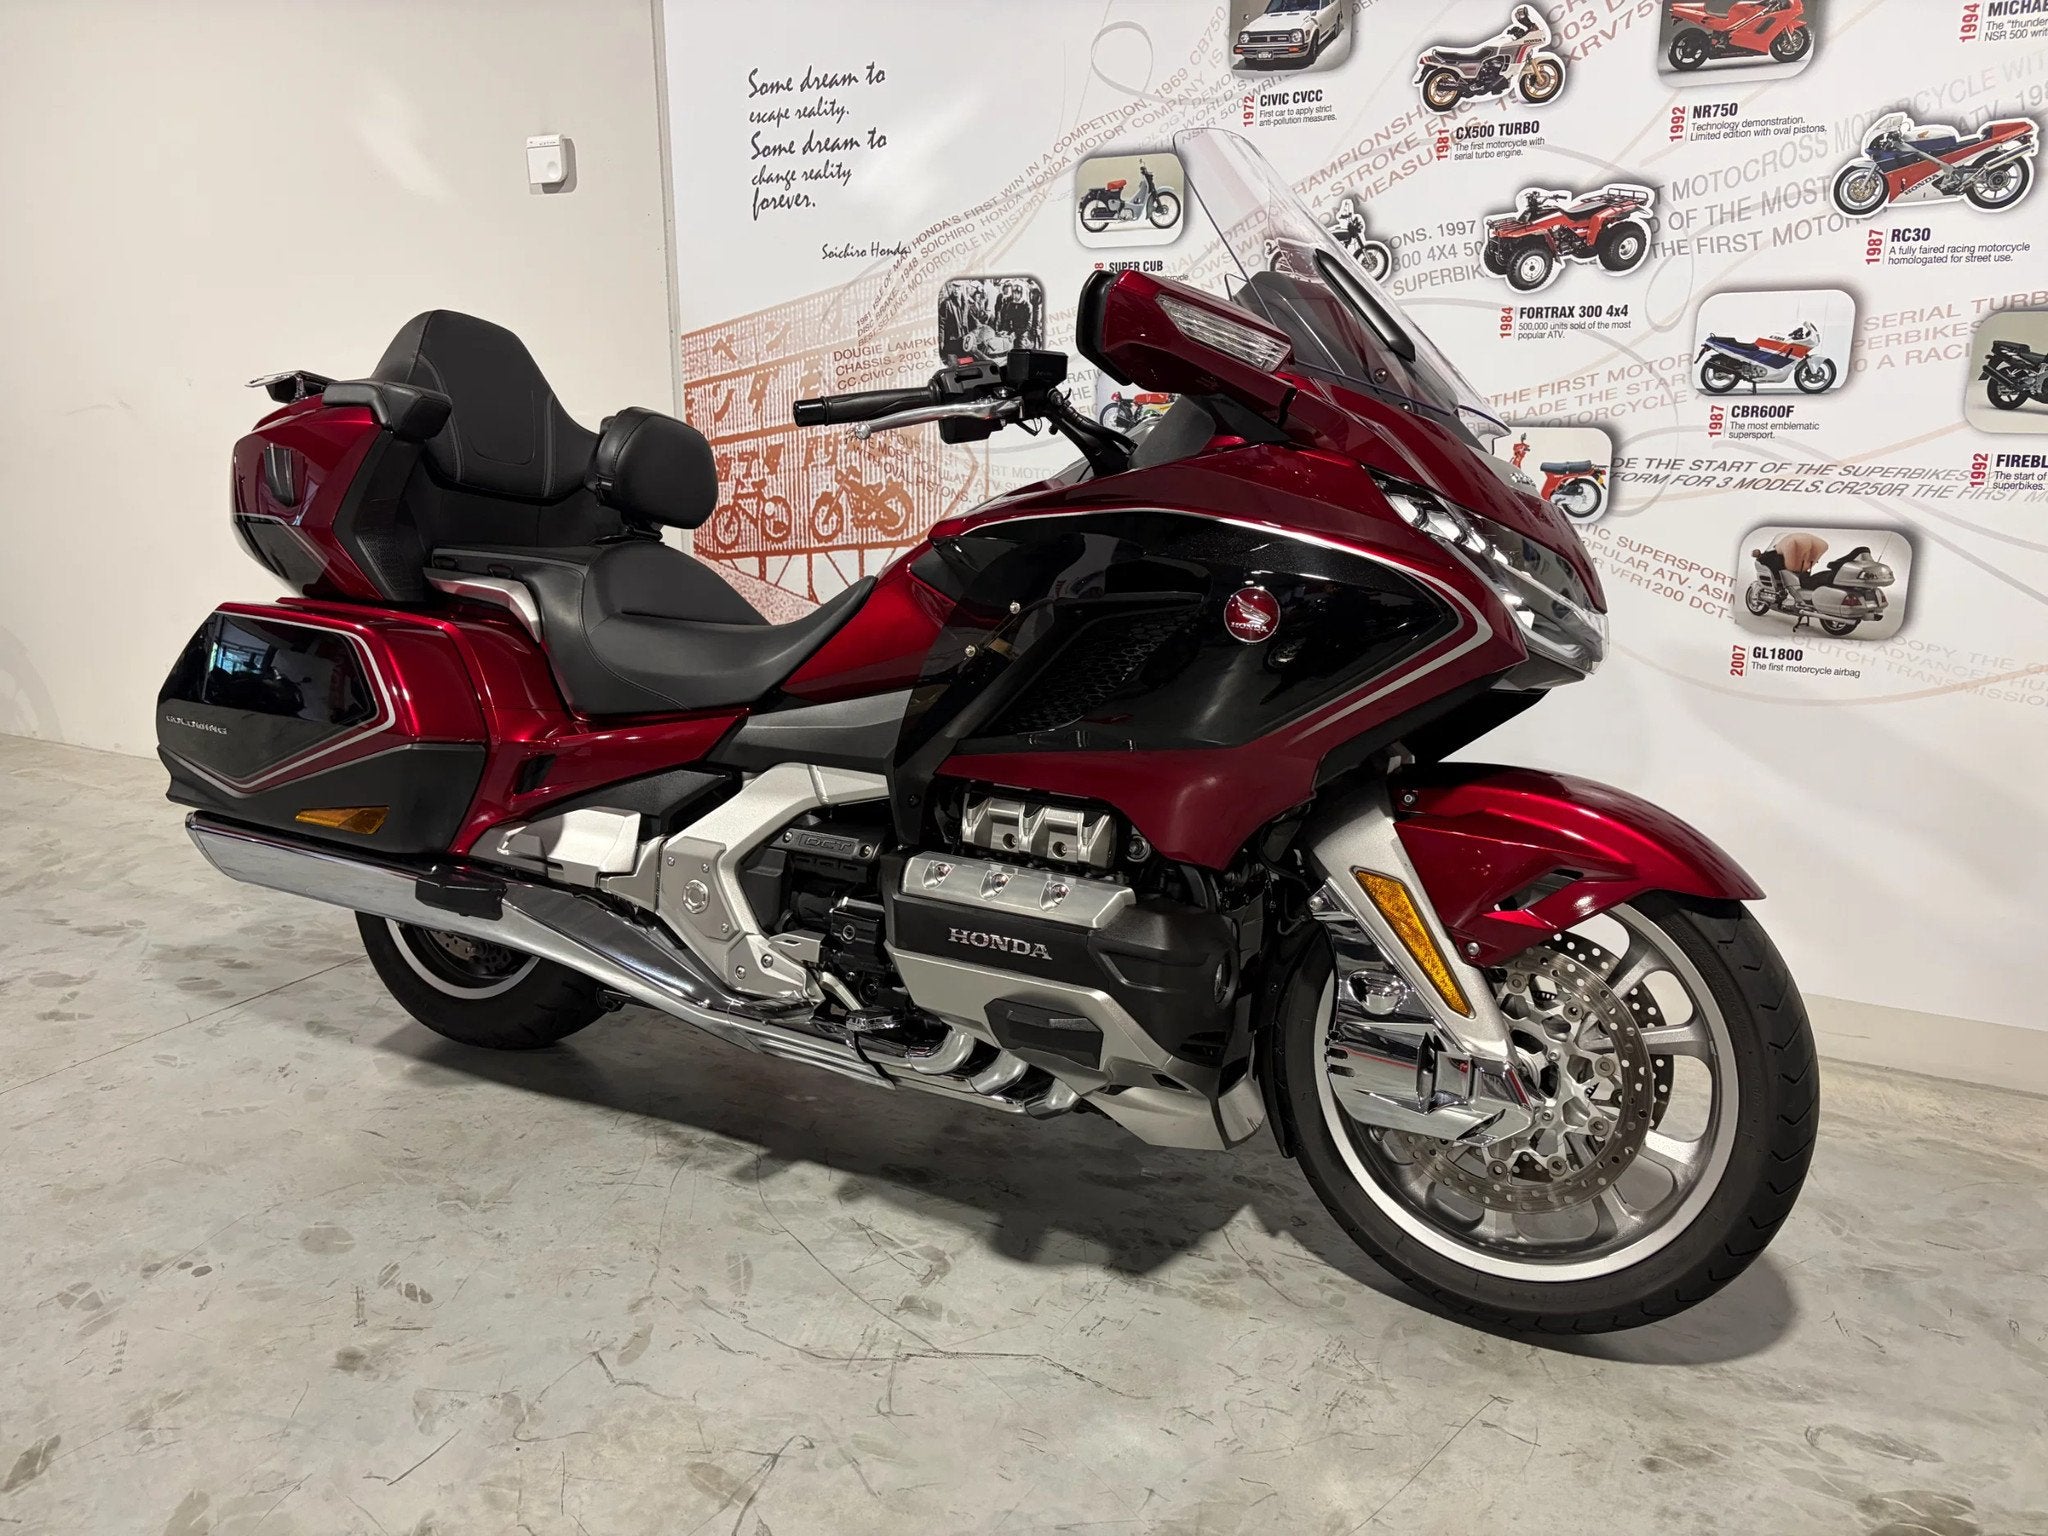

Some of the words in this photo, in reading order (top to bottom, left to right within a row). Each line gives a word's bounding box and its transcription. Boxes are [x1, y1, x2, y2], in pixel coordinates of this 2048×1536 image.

[1960, 3, 1980, 42] 1994
[1986, 21, 2004, 31] The
[1984, 31, 2007, 42] NSR
[2009, 29, 2028, 40] 500
[748, 67, 794, 99] Some
[800, 65, 860, 93] dream
[865, 61, 886, 85] to
[1260, 91, 1290, 107] CIVIC
[1292, 89, 1324, 104] CVCC
[749, 107, 791, 128] escape
[794, 96, 850, 125] reality.
[1243, 95, 1255, 127] 1972
[1259, 108, 1274, 119] First
[1274, 109, 1286, 117] car
[1287, 108, 1295, 116] to
[1295, 106, 1315, 117] apply
[1315, 104, 1332, 114] strict
[1259, 116, 1302, 127] anti-pollution
[1302, 114, 1338, 123] measures.
[1692, 102, 1739, 119] NR750
[911, 215, 962, 249] HONDA'S
[963, 196, 1001, 221] FIRST
[1000, 175, 1025, 199] WIN
[1025, 161, 1041, 179] IN
[1041, 151, 1054, 166] A
[1053, 97, 1153, 155] COMPETITION.
[1154, 67, 1190, 100] 1969
[1189, 5, 1228, 67] CB750
[1455, 124, 1495, 141] CX500
[1498, 120, 1541, 137] TURBO
[1669, 106, 1686, 142] 1992
[1690, 128, 1722, 142] Limited
[1722, 127, 1752, 140] edition
[1753, 127, 1772, 138] with
[1773, 125, 1790, 136] oval
[1791, 123, 1828, 137] pistons.
[1691, 118, 1741, 132] Technology
[1741, 115, 1806, 129] demonstration.
[750, 130, 796, 160] Some
[802, 129, 861, 155] dream
[866, 127, 888, 150] to
[919, 222, 976, 259] SOICHIRO
[980, 194, 1025, 228] HONDA
[1027, 155, 1073, 195] HONDA
[1072, 124, 1128, 159] MOTOR
[1131, 72, 1207, 129] COMPANY
[1208, 47, 1226, 70] IS
[1436, 128, 1450, 162] 1981
[1455, 142, 1469, 152] The
[1470, 141, 1485, 152] first
[1486, 138, 1528, 151] motorcycle
[1529, 136, 1546, 147] with
[1454, 151, 1474, 161] serial
[1475, 149, 1495, 160] turbo
[1496, 149, 1524, 159] engine.
[751, 164, 797, 192] change
[800, 159, 853, 187] reality
[1311, 132, 1422, 210] 4-STROKE
[1671, 133, 1829, 202] MOTOCROSS
[751, 187, 817, 222] forever.
[1668, 208, 1698, 231] OF
[1704, 195, 1752, 227] THE
[1761, 174, 1831, 217] MOST
[1436, 220, 1477, 238] 1997
[1891, 227, 1932, 244] RC30
[822, 243, 868, 261] Soichiro
[870, 241, 910, 259] Honda
[1427, 245, 1459, 262] 4X4
[1696, 230, 1764, 256] FIRST
[1865, 228, 1884, 266] 1987
[1888, 246, 1898, 256] A
[1898, 244, 1918, 258] fully
[1918, 243, 1946, 256] faired
[1946, 243, 1977, 257] racing
[1977, 241, 2031, 255] motorcycle
[907, 238, 982, 299] MOTORCYCLE
[1108, 261, 1140, 273] SUPER
[1142, 260, 1164, 272] CUB
[1887, 254, 1949, 267] homologated
[1950, 253, 1965, 264] for
[1965, 253, 1990, 264] street
[1991, 254, 2014, 264] use.
[1519, 306, 1576, 319] FORTRAX
[1578, 305, 1603, 318] 300
[1606, 303, 1629, 317] 4x4
[1863, 303, 1963, 332] SERIAL
[1499, 306, 1514, 340] 1984
[1549, 321, 1569, 330] units
[1569, 320, 1586, 330] sold
[1587, 320, 1597, 330] of
[1597, 320, 1610, 330] the
[1611, 320, 1632, 329] most
[1517, 330, 1546, 341] popular
[1546, 330, 1566, 340] ATV.
[833, 342, 883, 362] DOUGIE
[835, 356, 896, 377] CHASSIS.
[898, 350, 929, 364] 2001
[1490, 388, 1532, 408] THE
[1537, 372, 1600, 399] FIRST
[1574, 385, 1618, 407] THE
[1708, 405, 1725, 438] 1987
[1731, 405, 1796, 419] CBR600F
[1728, 431, 1776, 442] supersport.
[1730, 421, 1748, 431] The
[1748, 421, 1769, 432] most
[1769, 420, 1821, 432] emblematic
[1645, 457, 1686, 471] THE
[1688, 458, 1758, 474] START
[1761, 461, 1792, 476] OF
[1795, 462, 1838, 477] THE
[1839, 464, 1971, 484] SUPERBIKES
[1970, 453, 1989, 489] 1992
[1994, 471, 2010, 483] The
[2011, 472, 2035, 483] start
[2035, 472, 2048, 484] of
[1669, 474, 1717, 489] FOR
[1715, 476, 1734, 489] 3
[1911, 484, 1959, 500] THE
[1992, 481, 2047, 493] superbikes.
[1609, 564, 1685, 603] VFR1200
[1653, 566, 1693, 589] ATV.
[1730, 644, 1747, 677] 2007
[1752, 646, 1804, 662] GL1800
[1751, 661, 1767, 672] The
[1768, 662, 1785, 674] first
[1785, 664, 1833, 677] motorcycle
[1833, 667, 1861, 679] airbag
[805, 836, 852, 851] DCT
[947, 926, 1054, 961] HONDA
